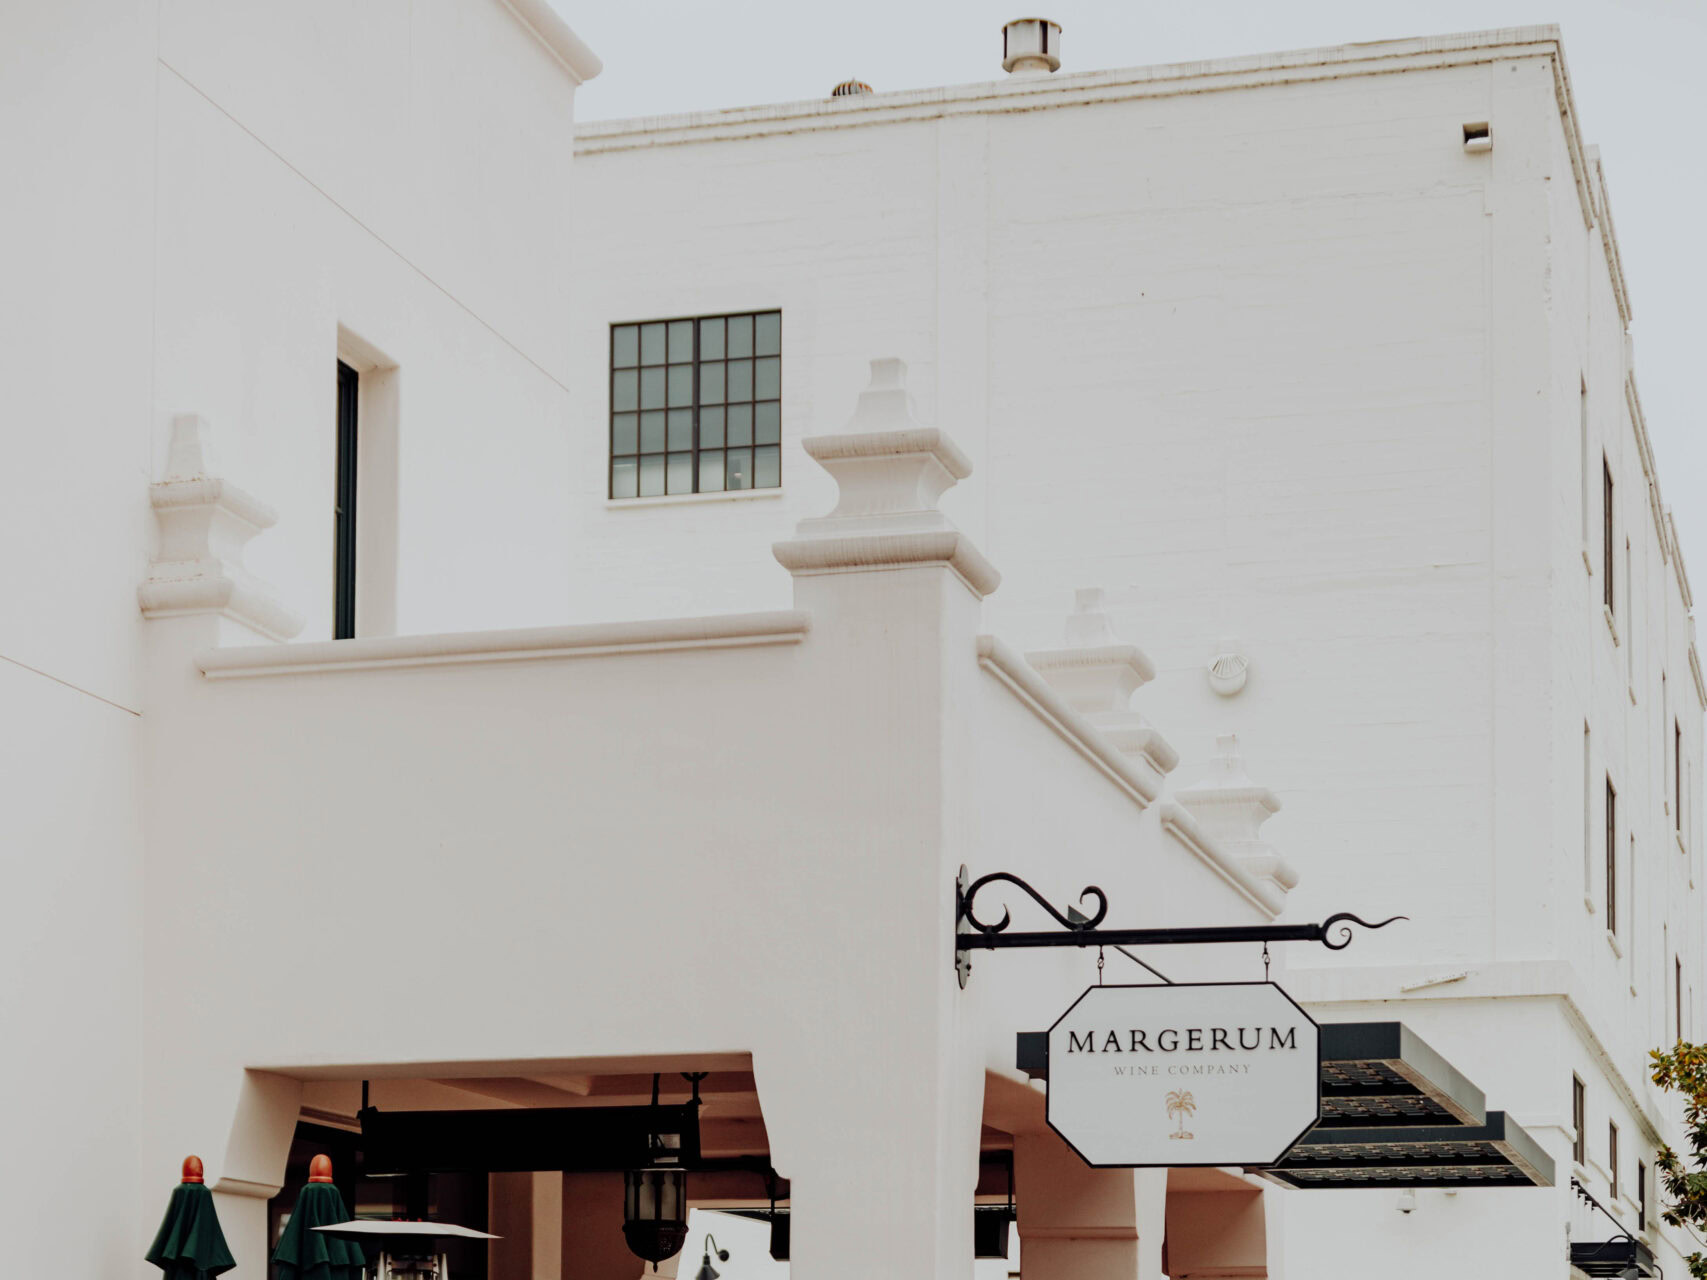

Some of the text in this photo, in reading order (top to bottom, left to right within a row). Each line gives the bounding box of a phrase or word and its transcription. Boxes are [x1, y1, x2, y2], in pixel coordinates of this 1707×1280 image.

[1067, 1026, 1298, 1053] MARGERUM
[1113, 1063, 1251, 1076] WINE COMPANY
